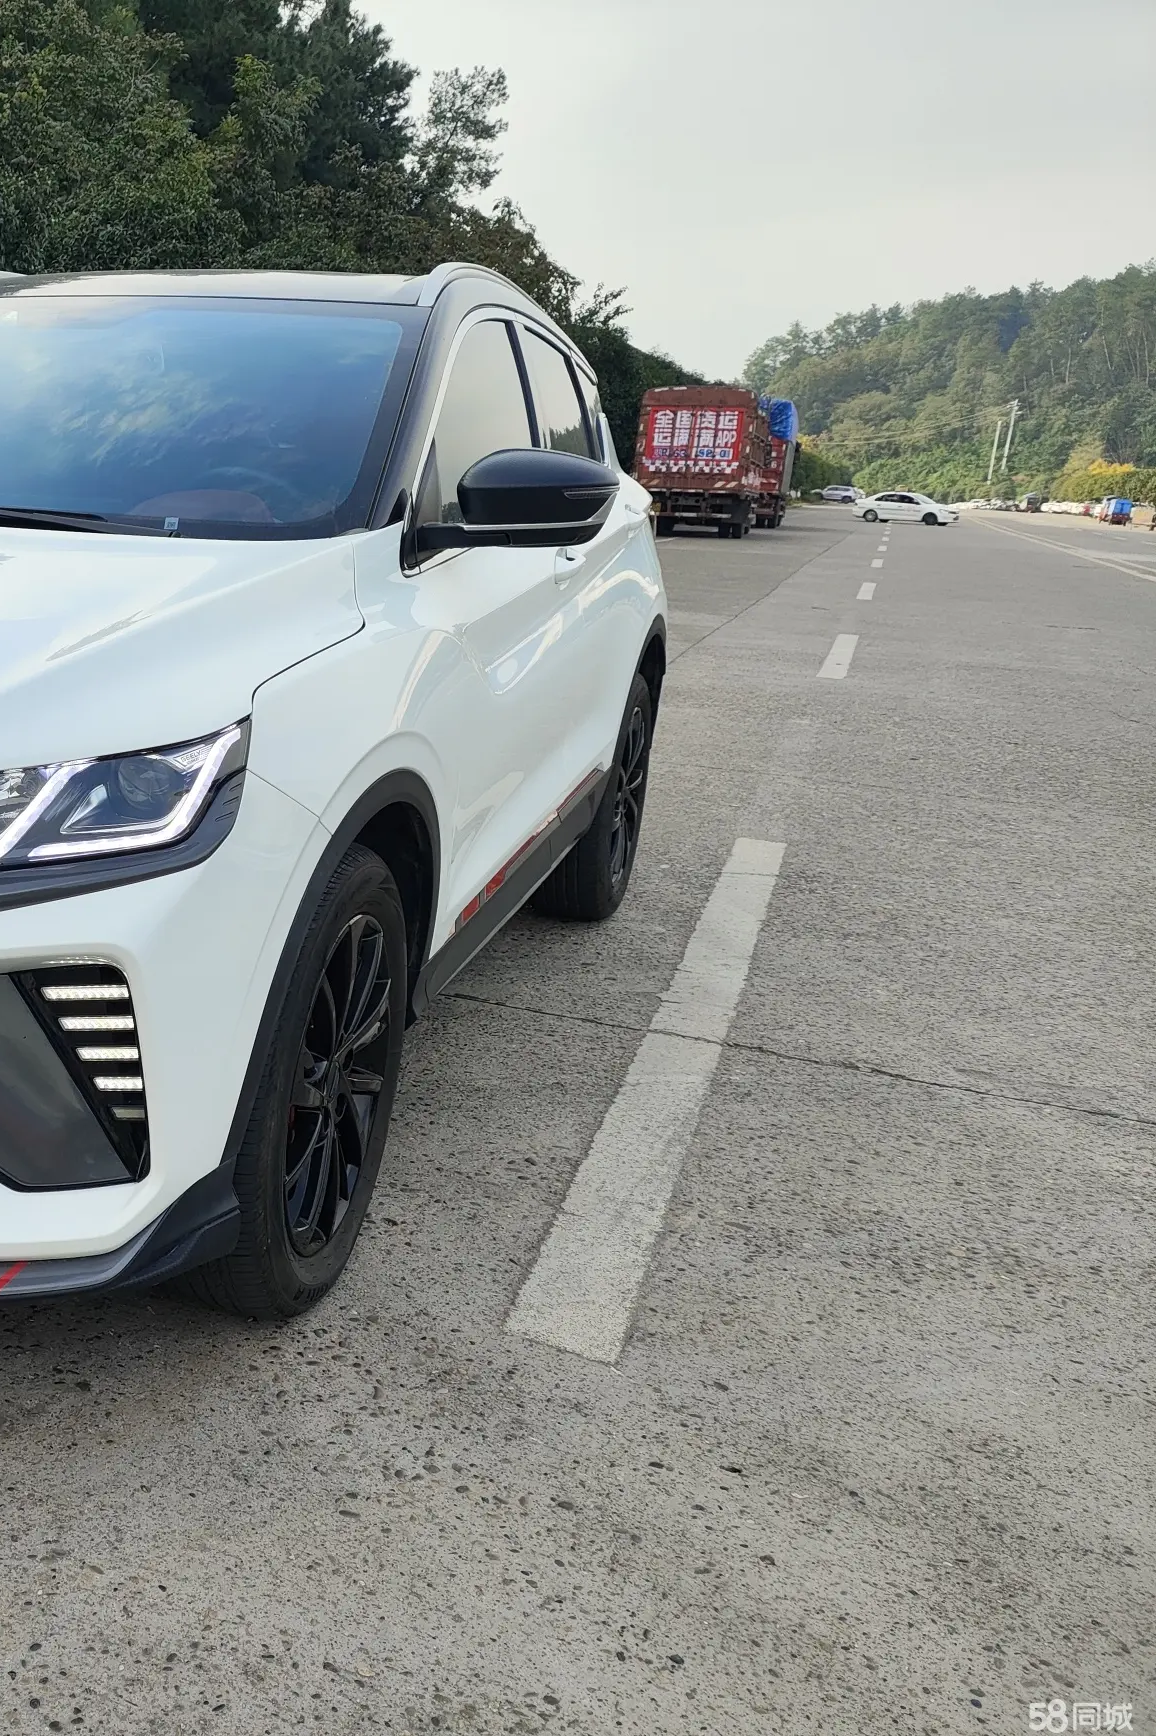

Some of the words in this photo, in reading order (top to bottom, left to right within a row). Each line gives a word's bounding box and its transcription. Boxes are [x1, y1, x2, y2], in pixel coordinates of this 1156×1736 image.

[653, 409, 739, 429] 全国货运
[180, 749, 201, 762] GEELY
